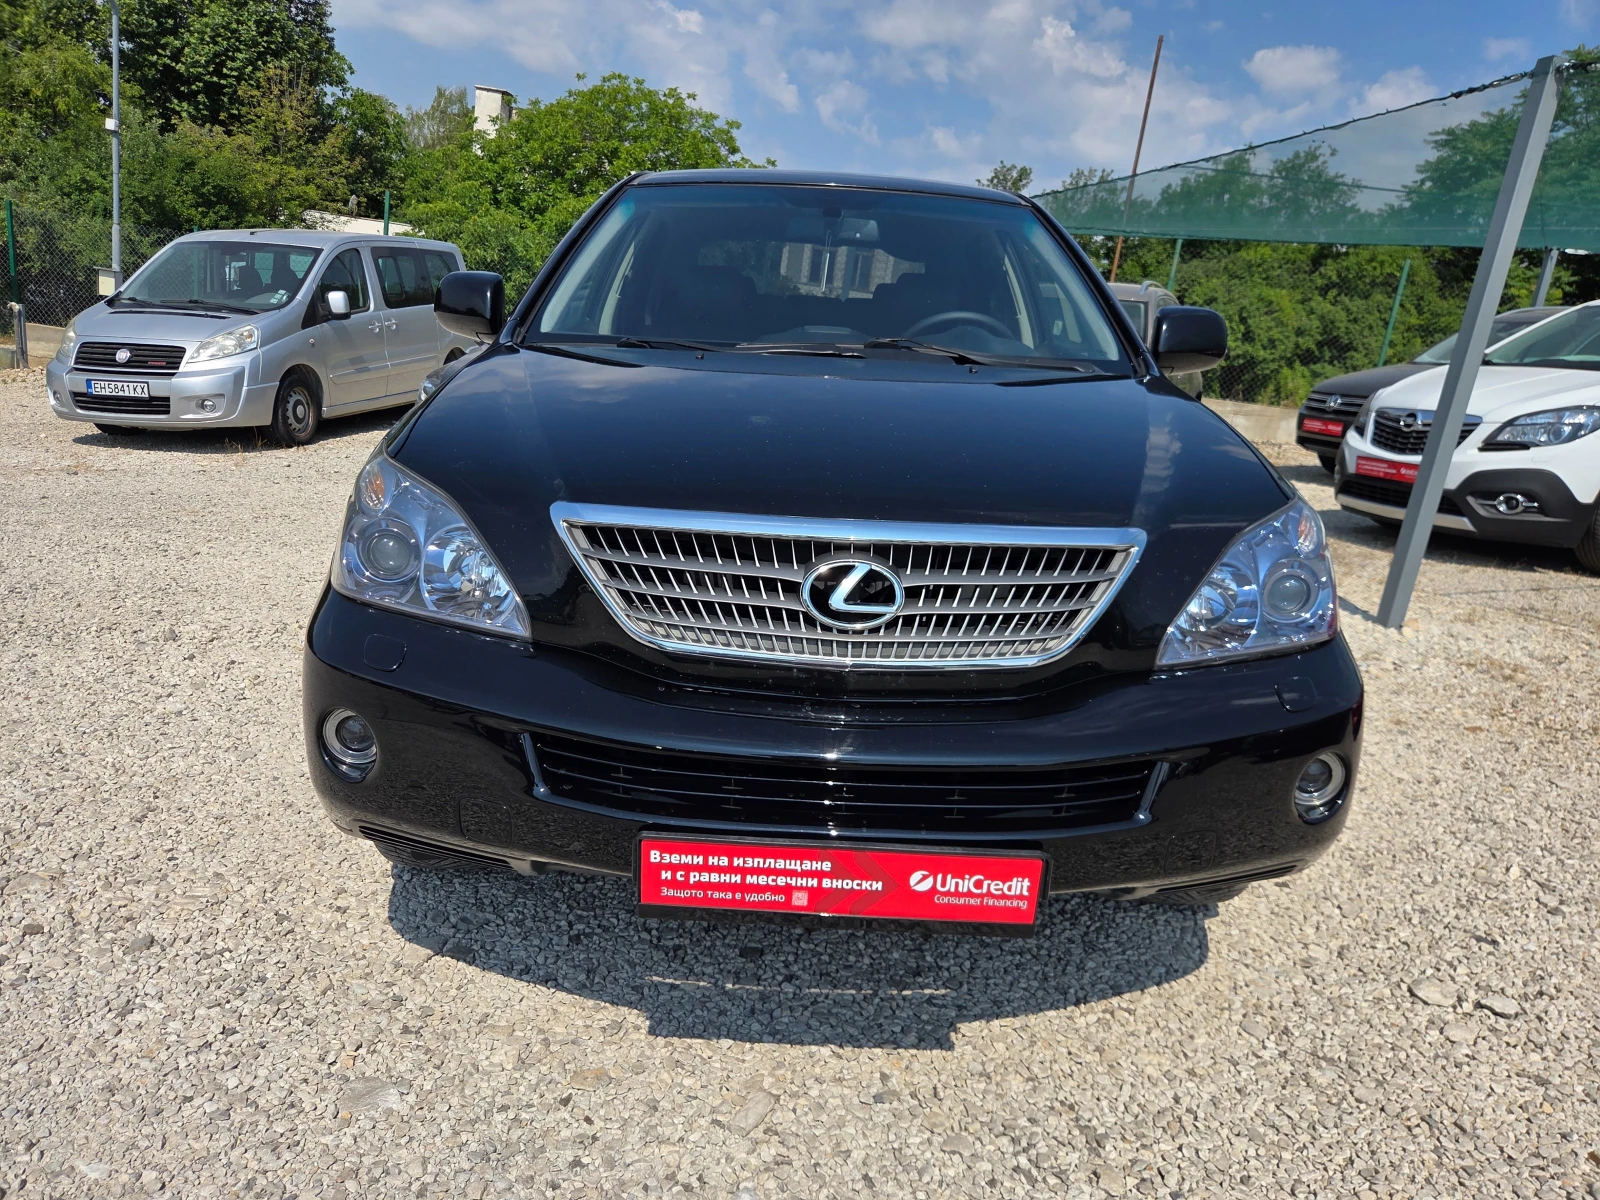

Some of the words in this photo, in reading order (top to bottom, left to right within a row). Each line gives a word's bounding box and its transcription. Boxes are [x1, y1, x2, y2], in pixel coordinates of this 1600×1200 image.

[649, 850, 704, 865] Вземи
[708, 854, 729, 867] на
[733, 855, 832, 872] изплащане
[661, 870, 672, 881] и
[675, 871, 685, 882] с
[689, 871, 742, 885] равни
[745, 873, 818, 888] месечни
[822, 878, 882, 891] вноски
[936, 873, 1031, 896] UniCredit
[660, 886, 704, 899] Защото
[706, 889, 733, 900] така
[735, 891, 742, 900] е
[744, 891, 785, 902] удобно
[934, 894, 982, 907] Consumer
[983, 896, 1029, 910] Financing
